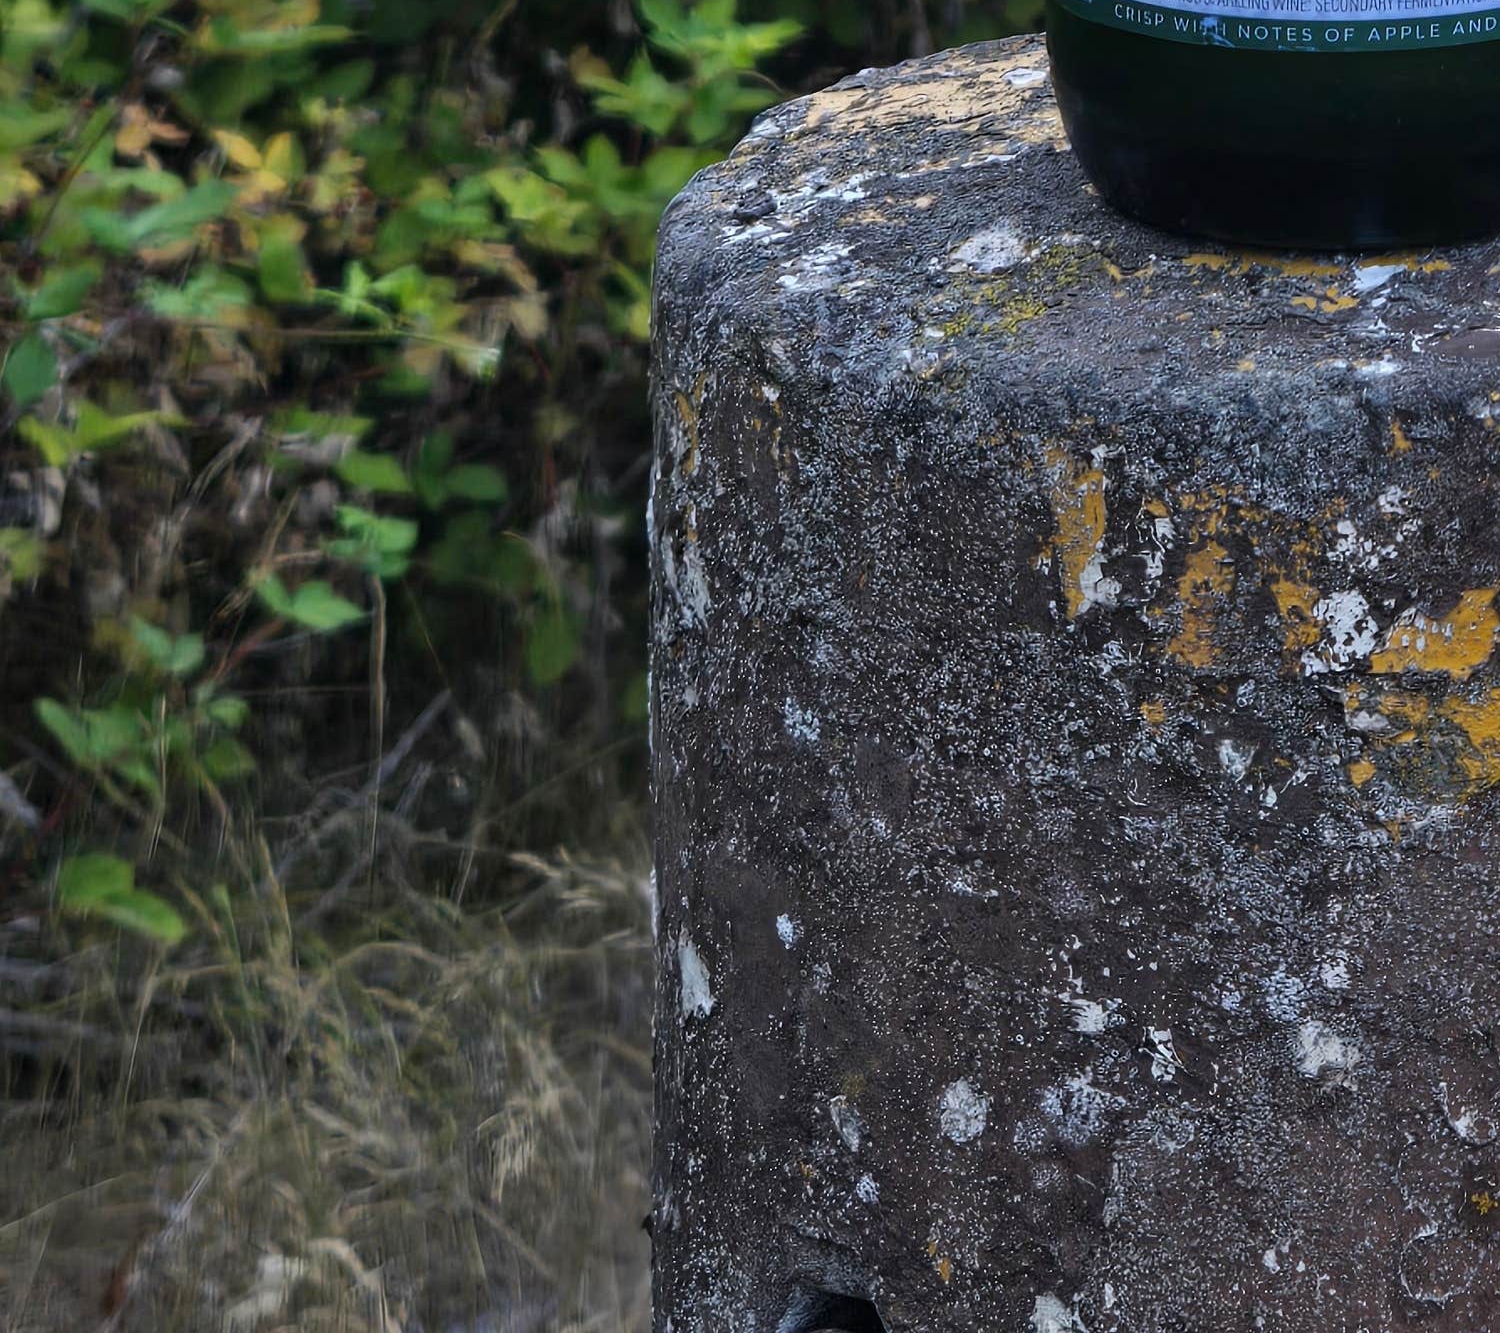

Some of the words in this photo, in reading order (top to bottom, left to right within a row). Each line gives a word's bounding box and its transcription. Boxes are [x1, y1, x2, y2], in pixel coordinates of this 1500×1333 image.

[1114, 4, 1164, 27] CRISP
[1238, 25, 1313, 41] NOTES
[1324, 27, 1355, 43] OF
[1367, 23, 1441, 42] APPLE
[1452, 16, 1497, 34] AND
